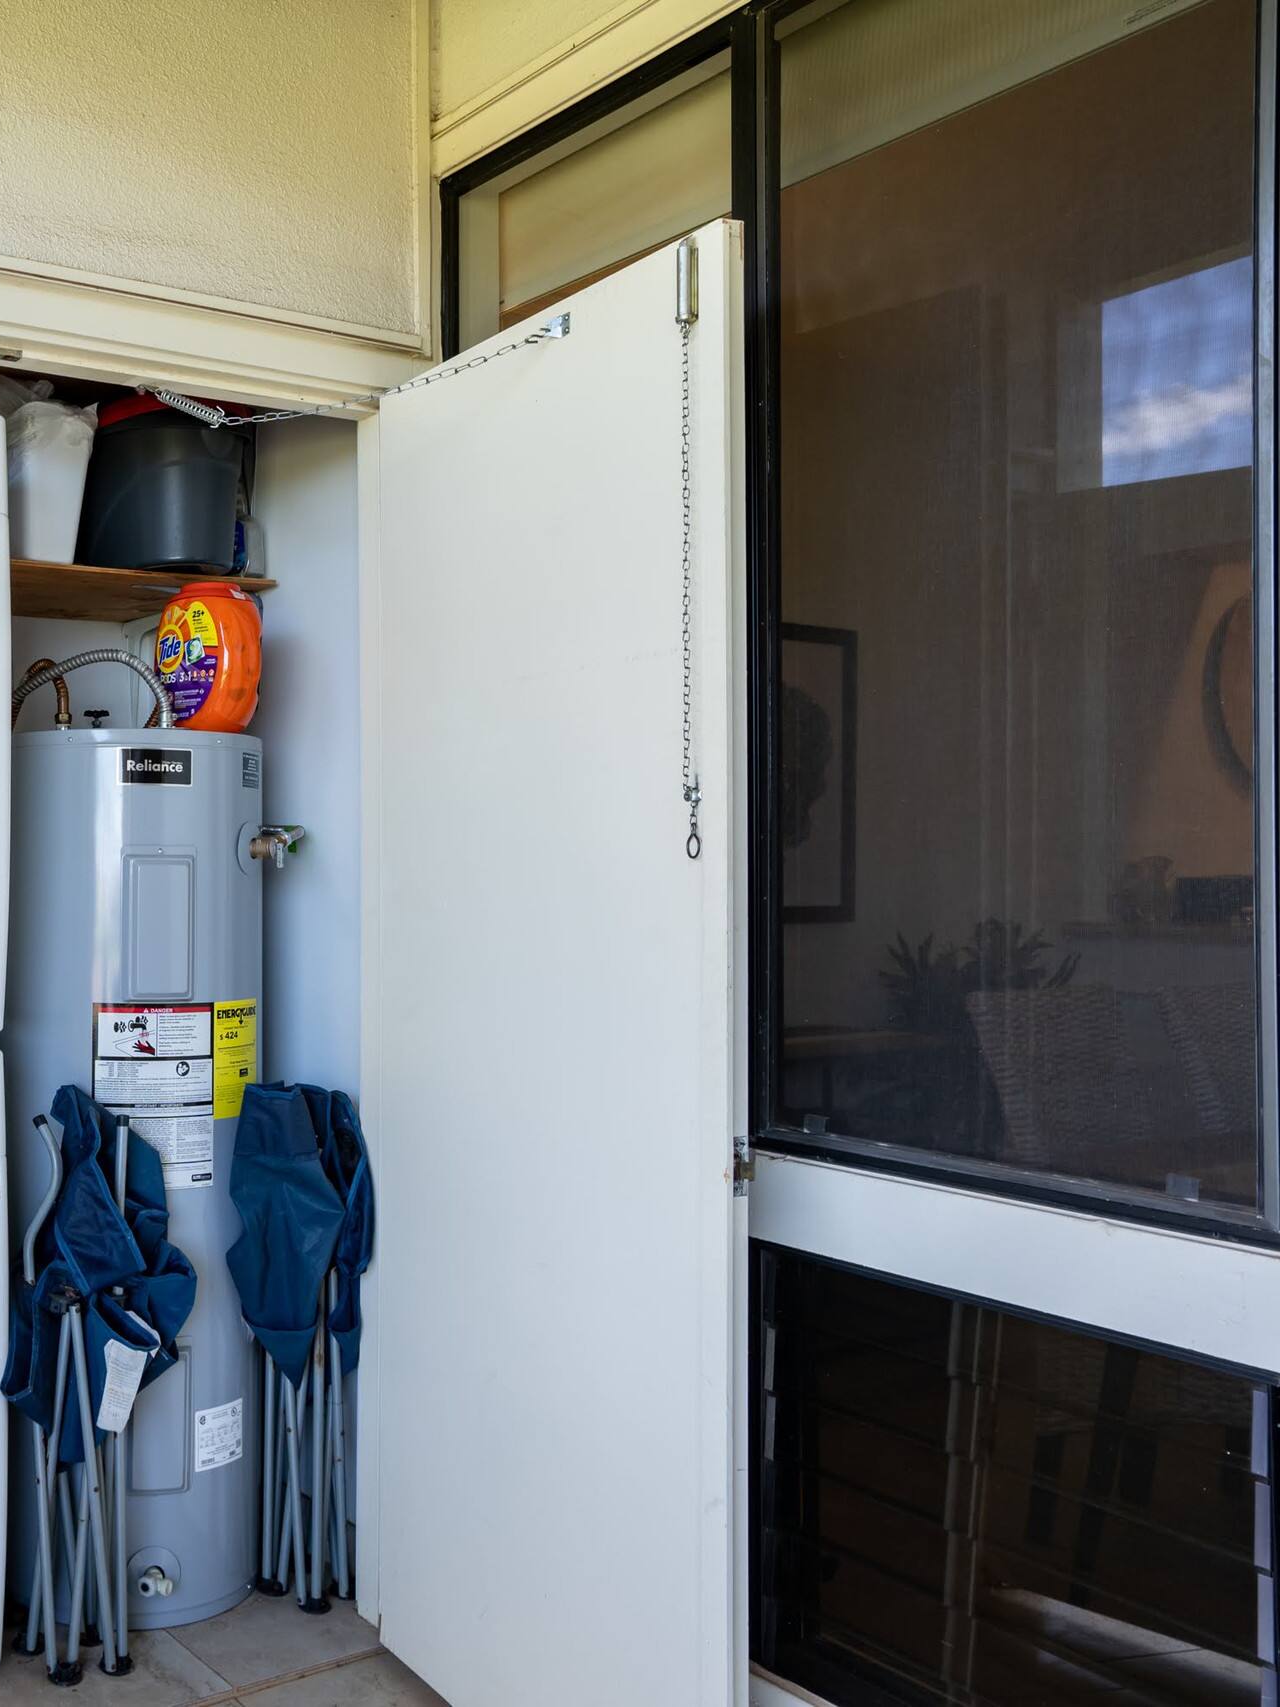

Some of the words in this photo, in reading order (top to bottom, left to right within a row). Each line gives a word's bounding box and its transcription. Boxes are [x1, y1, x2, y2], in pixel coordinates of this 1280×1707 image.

[158, 635, 182, 666] Tide
[126, 759, 184, 773] Reliance
[225, 1031, 238, 1040] 424
